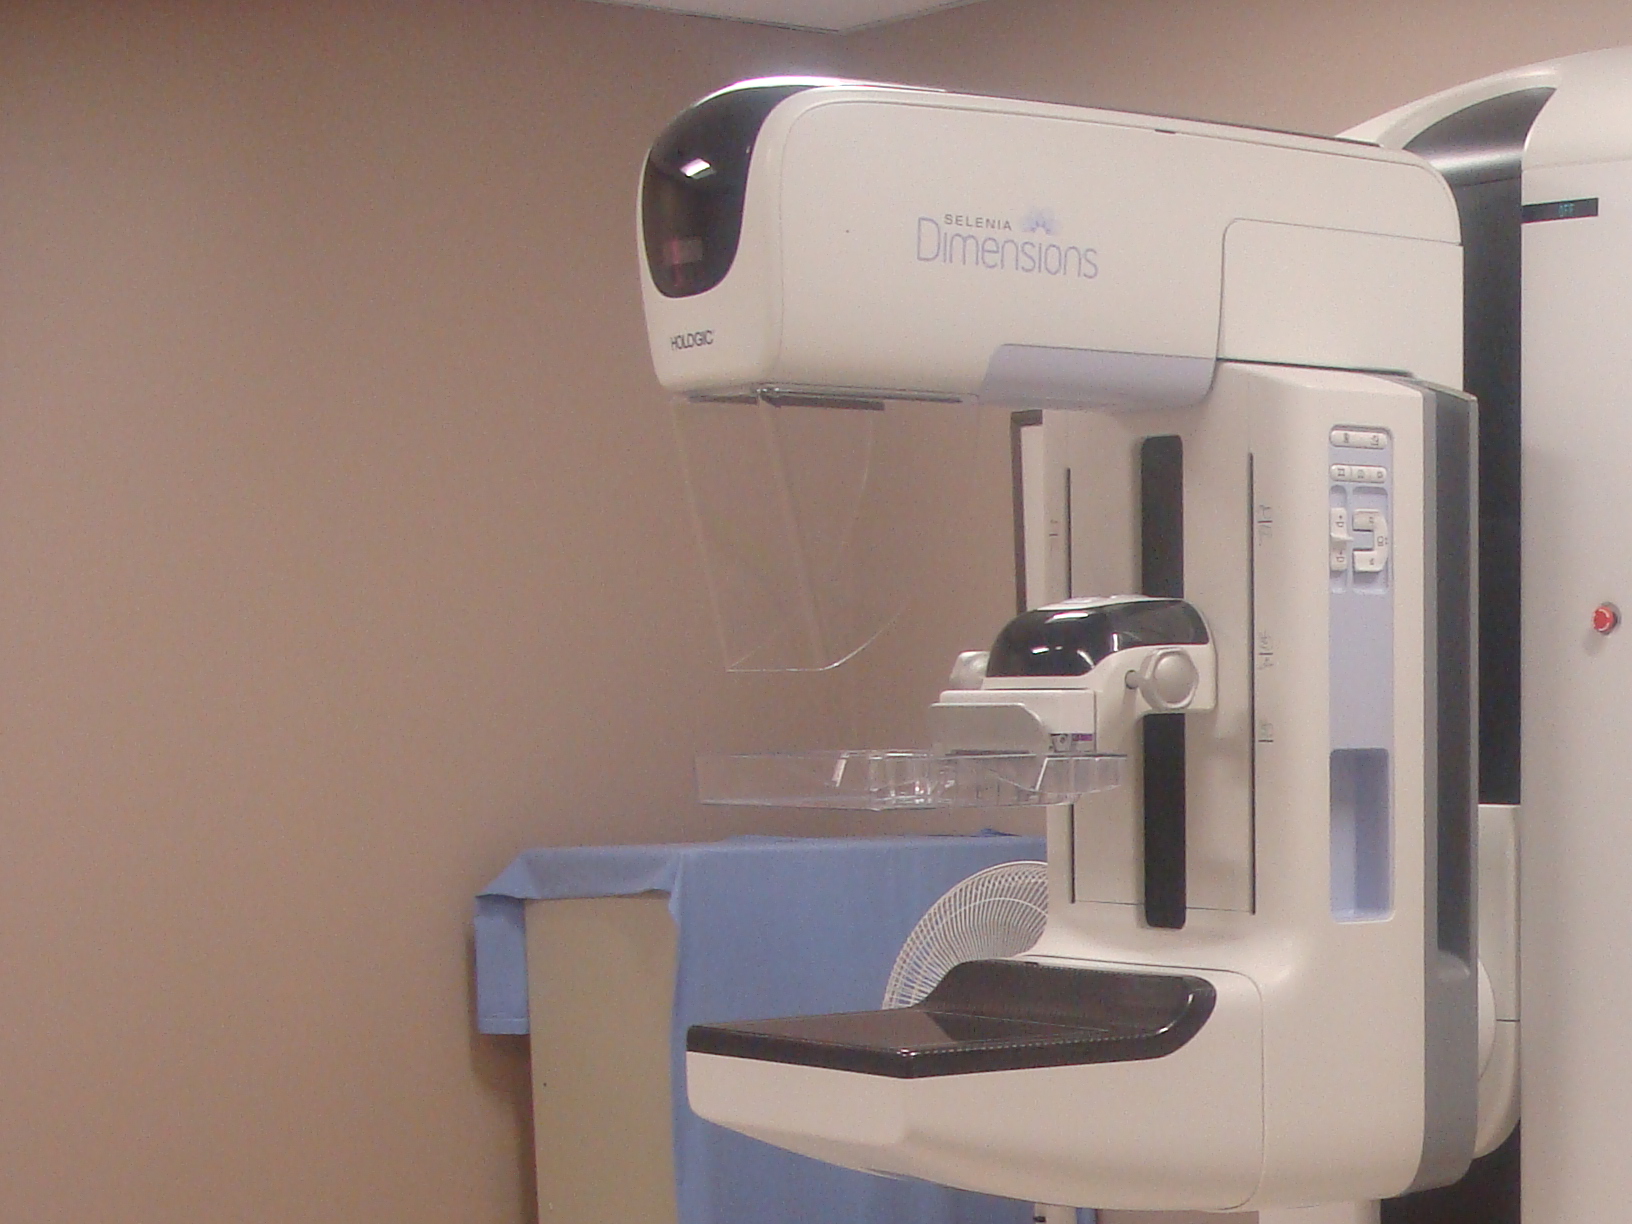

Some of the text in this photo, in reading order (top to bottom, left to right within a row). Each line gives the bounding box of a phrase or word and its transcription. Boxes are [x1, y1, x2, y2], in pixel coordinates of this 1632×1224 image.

[943, 213, 1013, 231] SELENIA
[916, 216, 1099, 279] Dimensions
[670, 329, 714, 351] HOLOGIC
